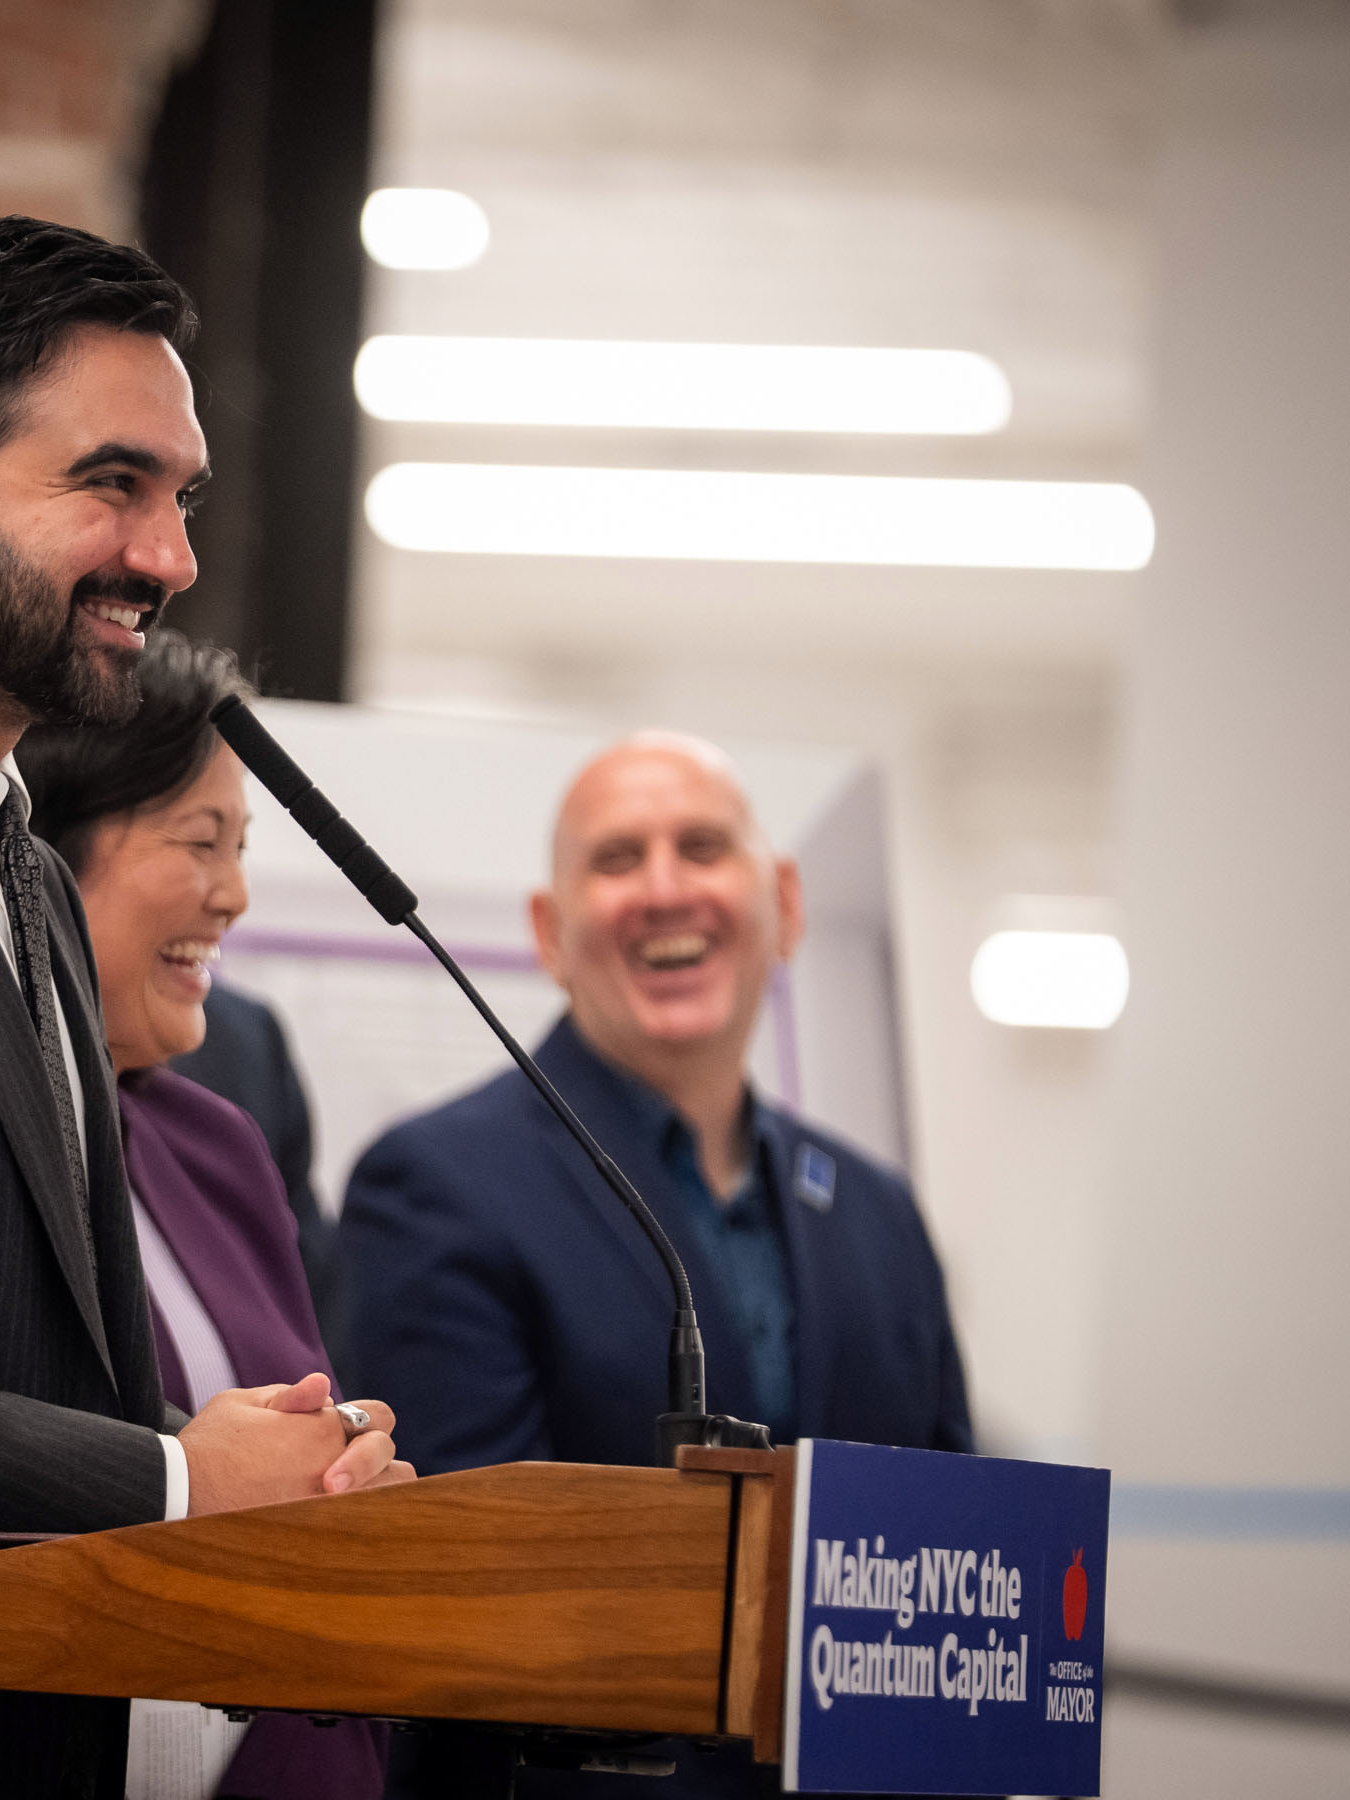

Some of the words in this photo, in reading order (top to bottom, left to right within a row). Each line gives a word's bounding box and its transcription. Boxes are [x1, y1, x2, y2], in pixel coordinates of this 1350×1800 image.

[814, 1535, 917, 1628] Making
[918, 1547, 977, 1616] NYC
[980, 1549, 1021, 1619] the
[811, 1624, 936, 1710] Quantum
[939, 1628, 1028, 1716] Capital
[1058, 1661, 1082, 1680] OFFICE
[1046, 1686, 1095, 1723] MAYOR
